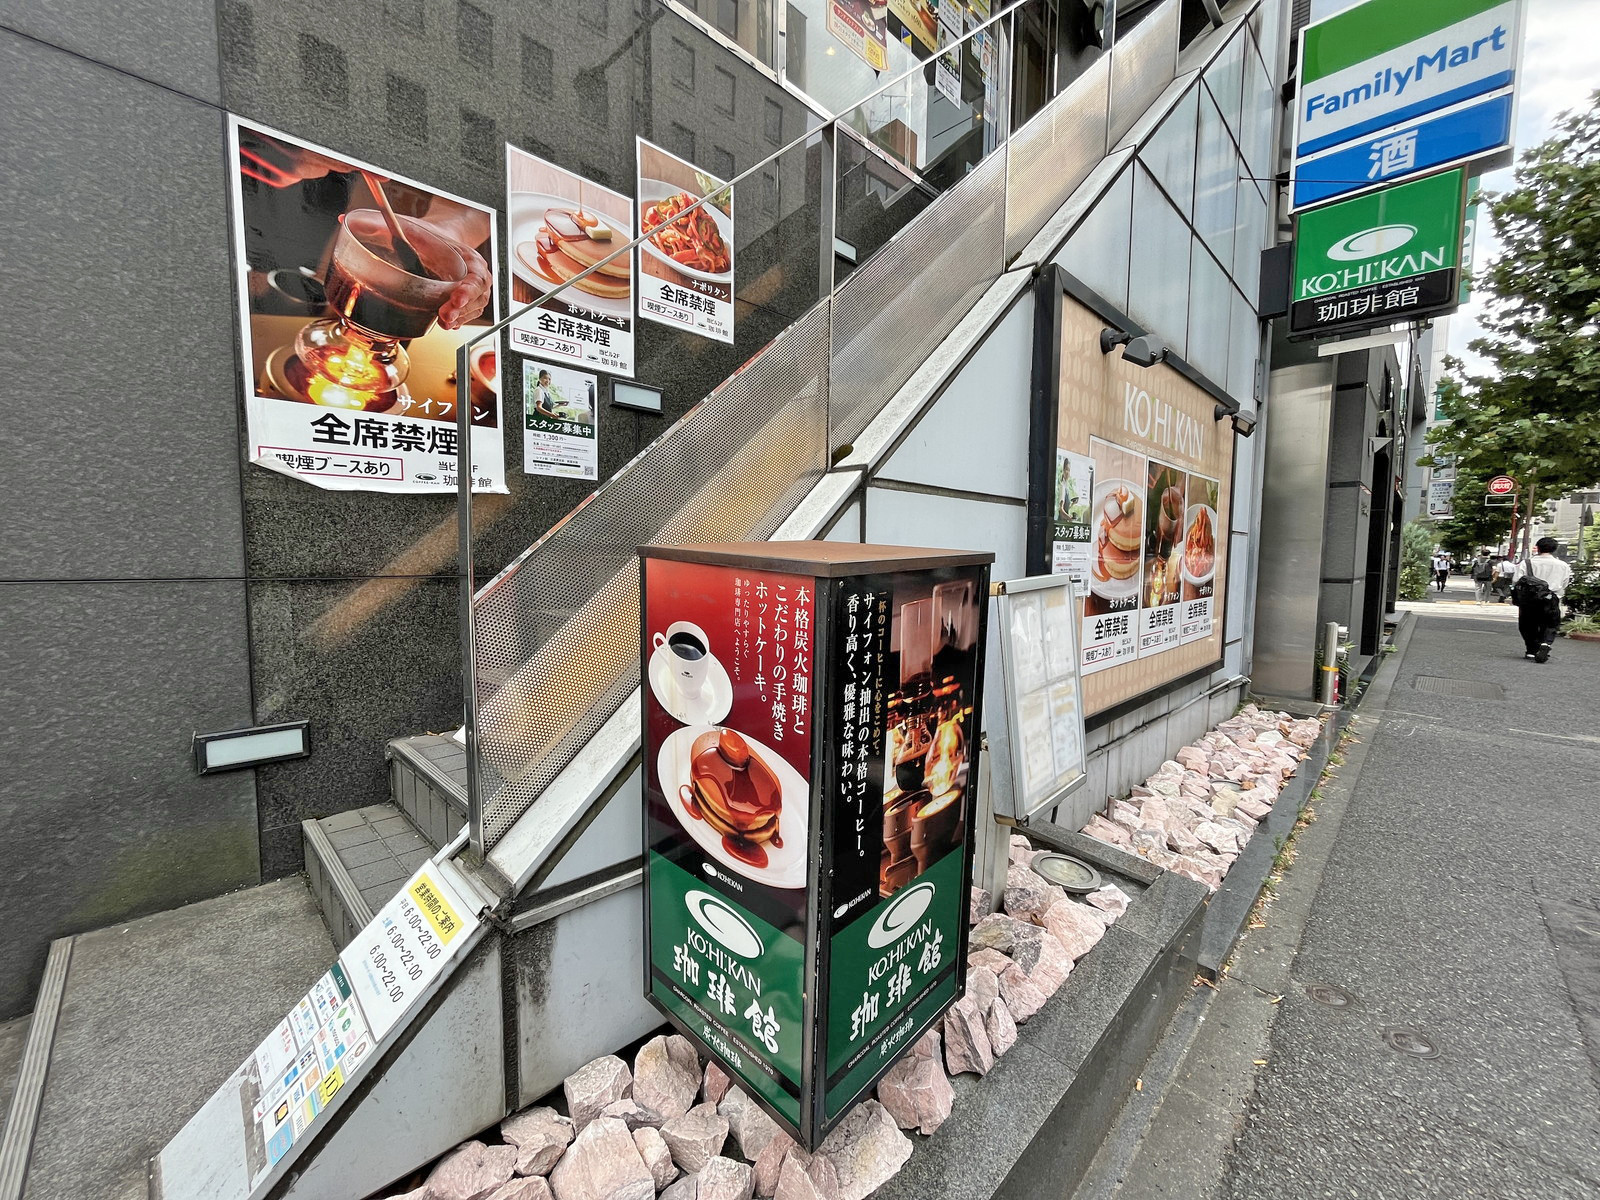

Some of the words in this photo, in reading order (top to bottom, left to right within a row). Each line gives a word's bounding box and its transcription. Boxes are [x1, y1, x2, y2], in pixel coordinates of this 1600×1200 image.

[1305, 24, 1506, 122] FamilyMart
[1366, 129, 1418, 179] 酒
[660, 284, 716, 317] 全席禁煙
[691, 279, 729, 299] ナポリタン
[1317, 286, 1420, 322] 珈琲館
[1360, 286, 1378, 294] COFFEE
[567, 303, 626, 328] ホットケーキ
[647, 301, 689, 322] 喫煙ブースあり
[520, 332, 576, 354] 喫煙ブースあり
[537, 312, 611, 348] 全席禁煙
[601, 357, 628, 370] 珈琲館
[397, 395, 490, 422] サイフン
[310, 412, 458, 456] 全席禁煙
[528, 418, 592, 437] スタッフ募集中
[438, 461, 479, 473] 当ビF
[1054, 525, 1090, 540] スタッフ募集中
[743, 579, 751, 659] ゆったりやすらぐ
[1109, 595, 1137, 609] ホットケーキ
[1148, 607, 1174, 629] 全席禁煙
[1187, 600, 1208, 619] 全席禁煙
[734, 577, 742, 681] 珈琲専門店へようこそ。
[753, 581, 769, 702] ホットケーキ。
[1094, 615, 1129, 640] 全席禁煙
[771, 583, 788, 742] こだわりの手焼き
[792, 585, 811, 736] 本格炭火珈琲と
[872, 590, 888, 757] 一杯のコーヒーに心をこめて。
[840, 594, 860, 804] 香り高く、優雅な味わい。
[855, 592, 876, 858] サイフォン抽出の本格コーヒー。
[400, 898, 409, 910] 平日
[414, 882, 455, 935] 営業時間のご案内
[673, 943, 781, 1054] 珈琲館
[849, 927, 944, 1042] 珈琲館
[672, 985, 693, 1006] CHARCOAL
[693, 1003, 712, 1022] ROASTED
[712, 1020, 729, 1037] COFFEE
[733, 1037, 762, 1065] ESTABLISHED
[871, 1025, 890, 1046] ROASTED
[890, 1011, 904, 1028] COFFEE
[324, 1071, 339, 1098] iD
